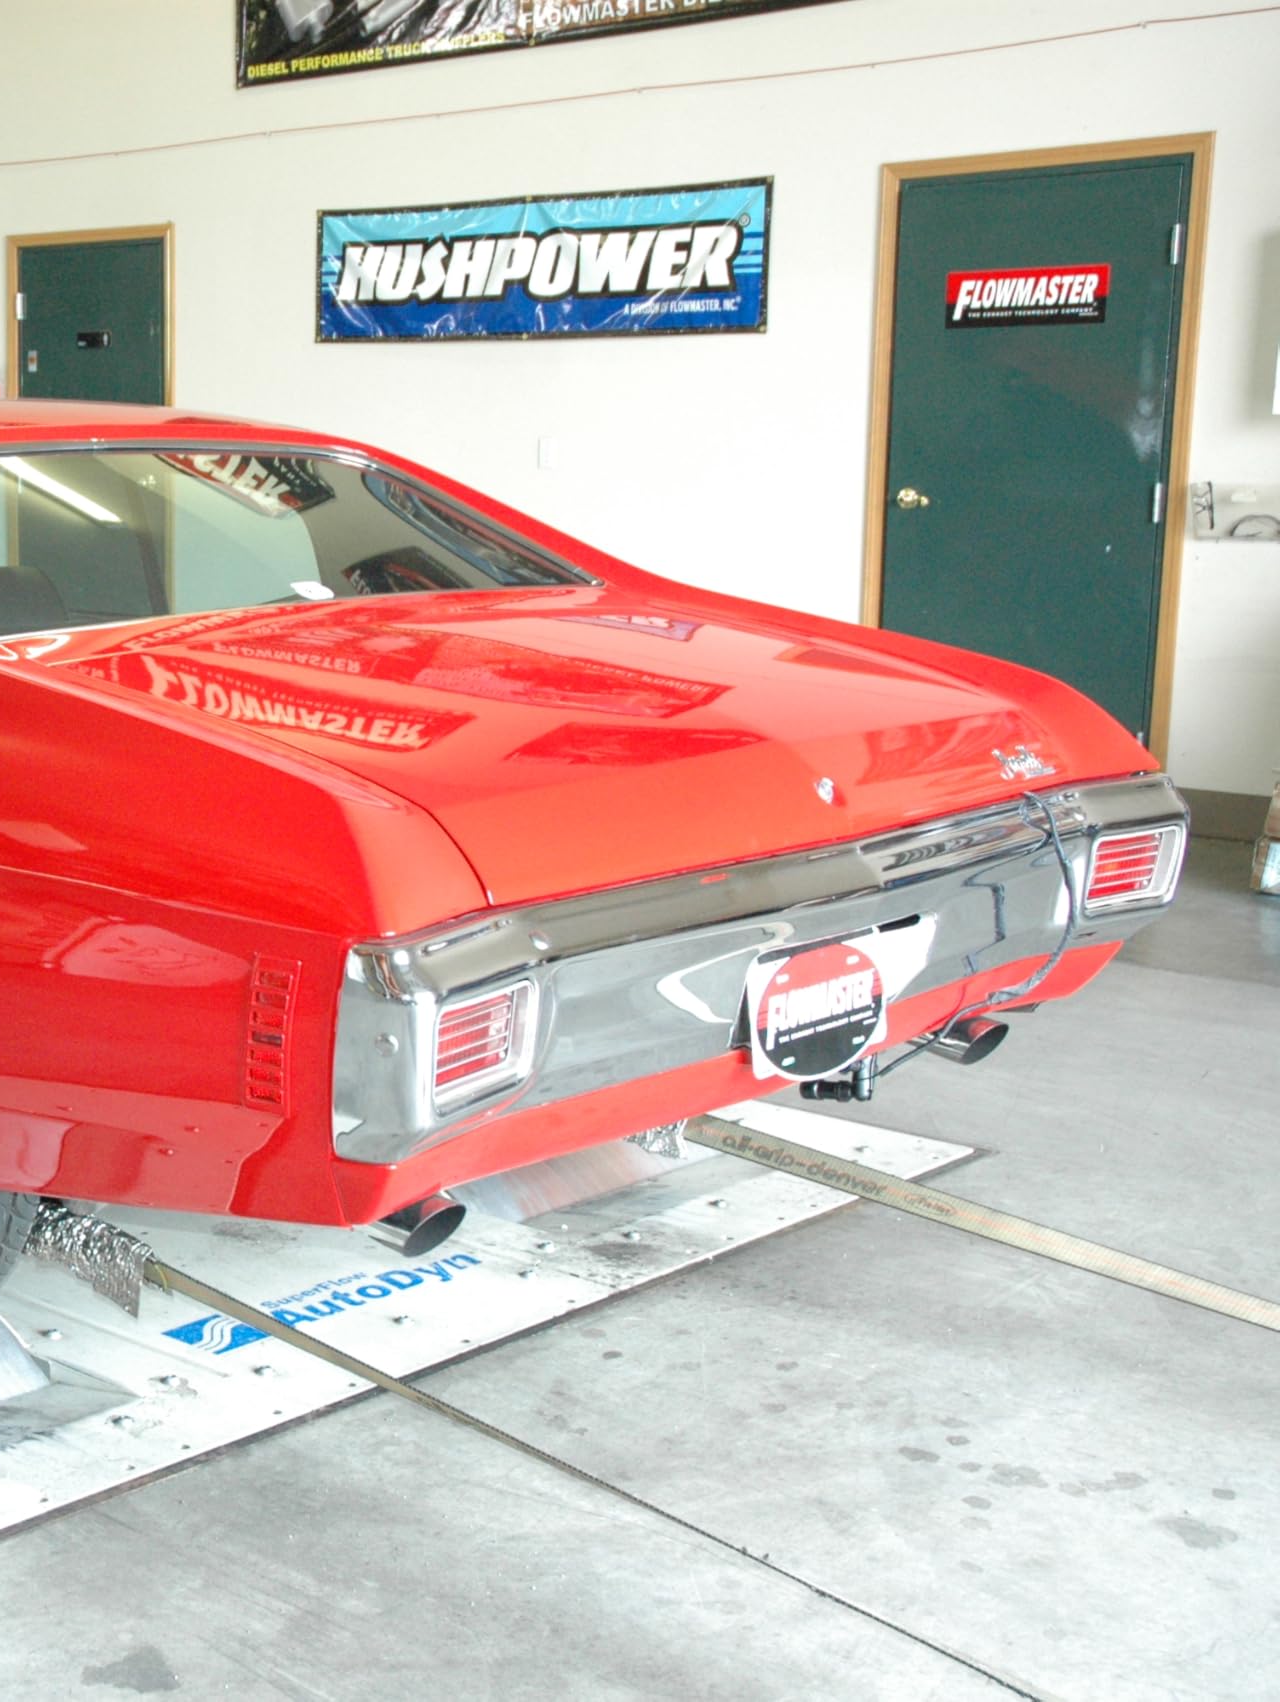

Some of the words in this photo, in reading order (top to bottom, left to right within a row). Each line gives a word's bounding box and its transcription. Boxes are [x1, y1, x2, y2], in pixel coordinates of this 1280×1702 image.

[247, 59, 289, 79] DIESEL
[290, 49, 384, 73] PERFORMANCE
[386, 40, 432, 59] TRUCK
[335, 224, 739, 302] HUSHPOWER
[951, 273, 1100, 322] FLOWMASTER
[765, 967, 876, 1050] FLOWMASTER
[269, 1252, 483, 1328] AutoDyn
